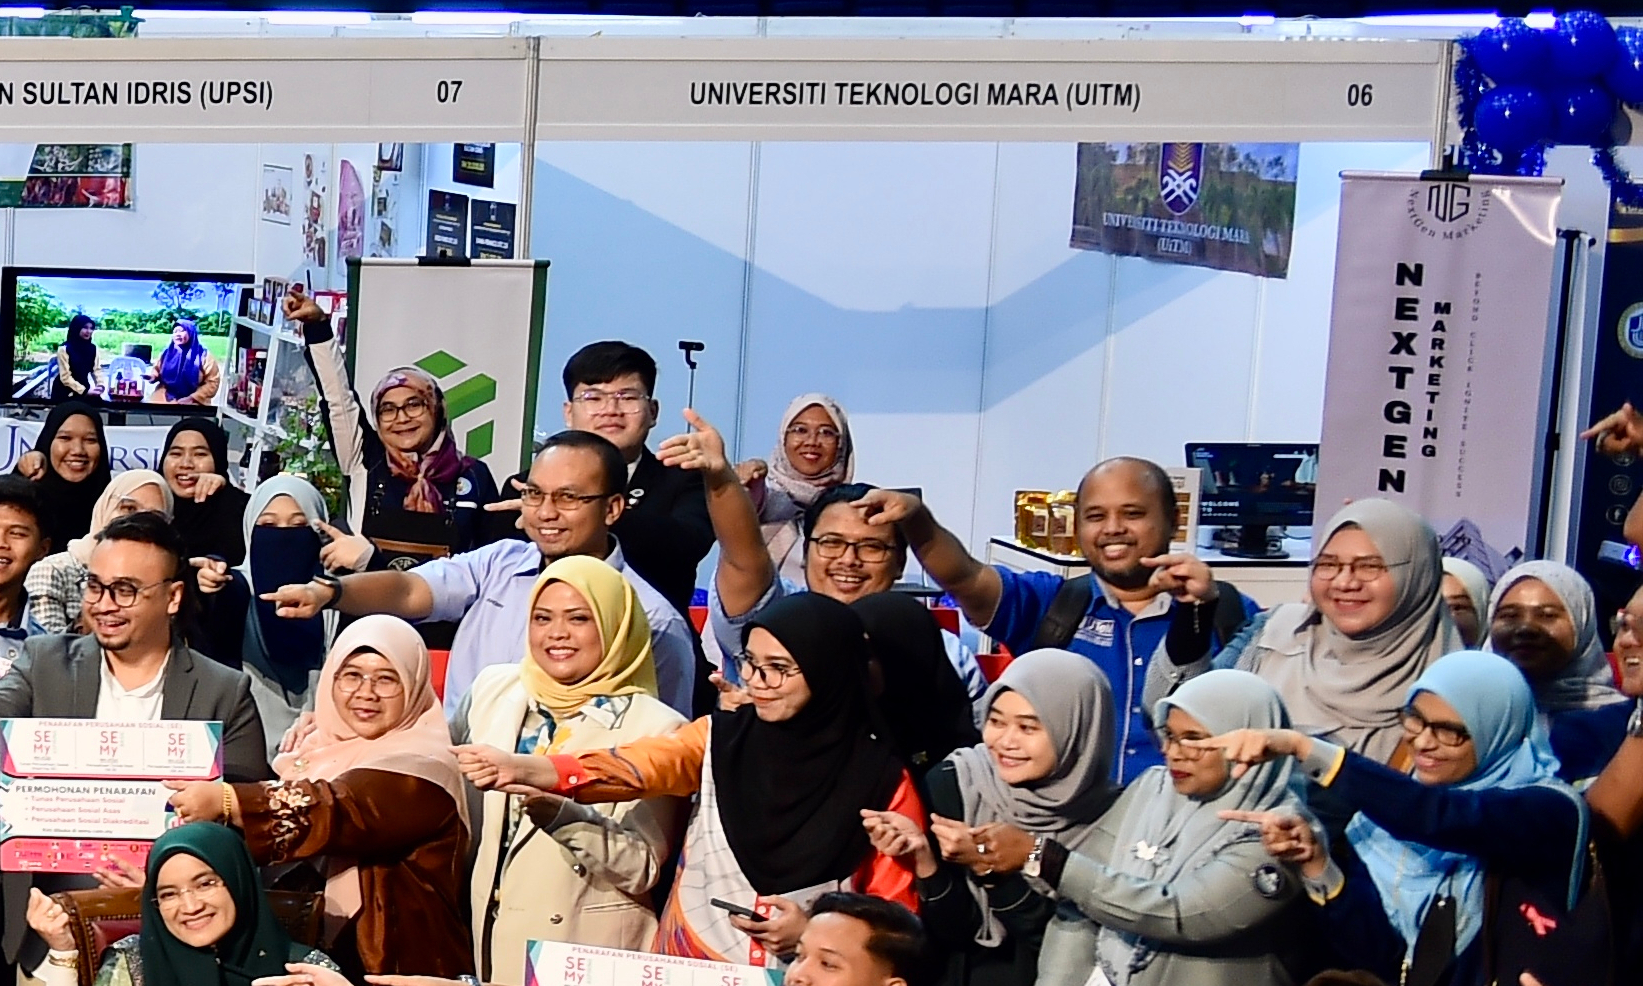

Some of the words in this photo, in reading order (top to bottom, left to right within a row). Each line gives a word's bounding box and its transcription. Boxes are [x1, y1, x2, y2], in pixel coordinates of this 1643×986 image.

[22, 81, 118, 105] SULTAN
[127, 81, 192, 105] IDRIS
[200, 81, 273, 110] (UPSI)
[437, 80, 463, 103] 07
[690, 82, 826, 105] UNIVERSITI
[834, 82, 979, 106] TEKNOLOGI
[987, 83, 1059, 106] MARA
[1066, 83, 1141, 112] (UITM)
[1347, 83, 1373, 107] 06
[1103, 212, 1158, 231] UNIVERSITI
[1160, 219, 1220, 239] TEKNOLOGI
[1221, 227, 1250, 244] MARA
[1157, 238, 1192, 255] (UiTM)
[1378, 263, 1423, 493] NEXTGEN
[1421, 302, 1451, 458] MARKETING
[16, 785, 90, 794] PERMOHONAN
[94, 787, 156, 796] PENARAFAN
